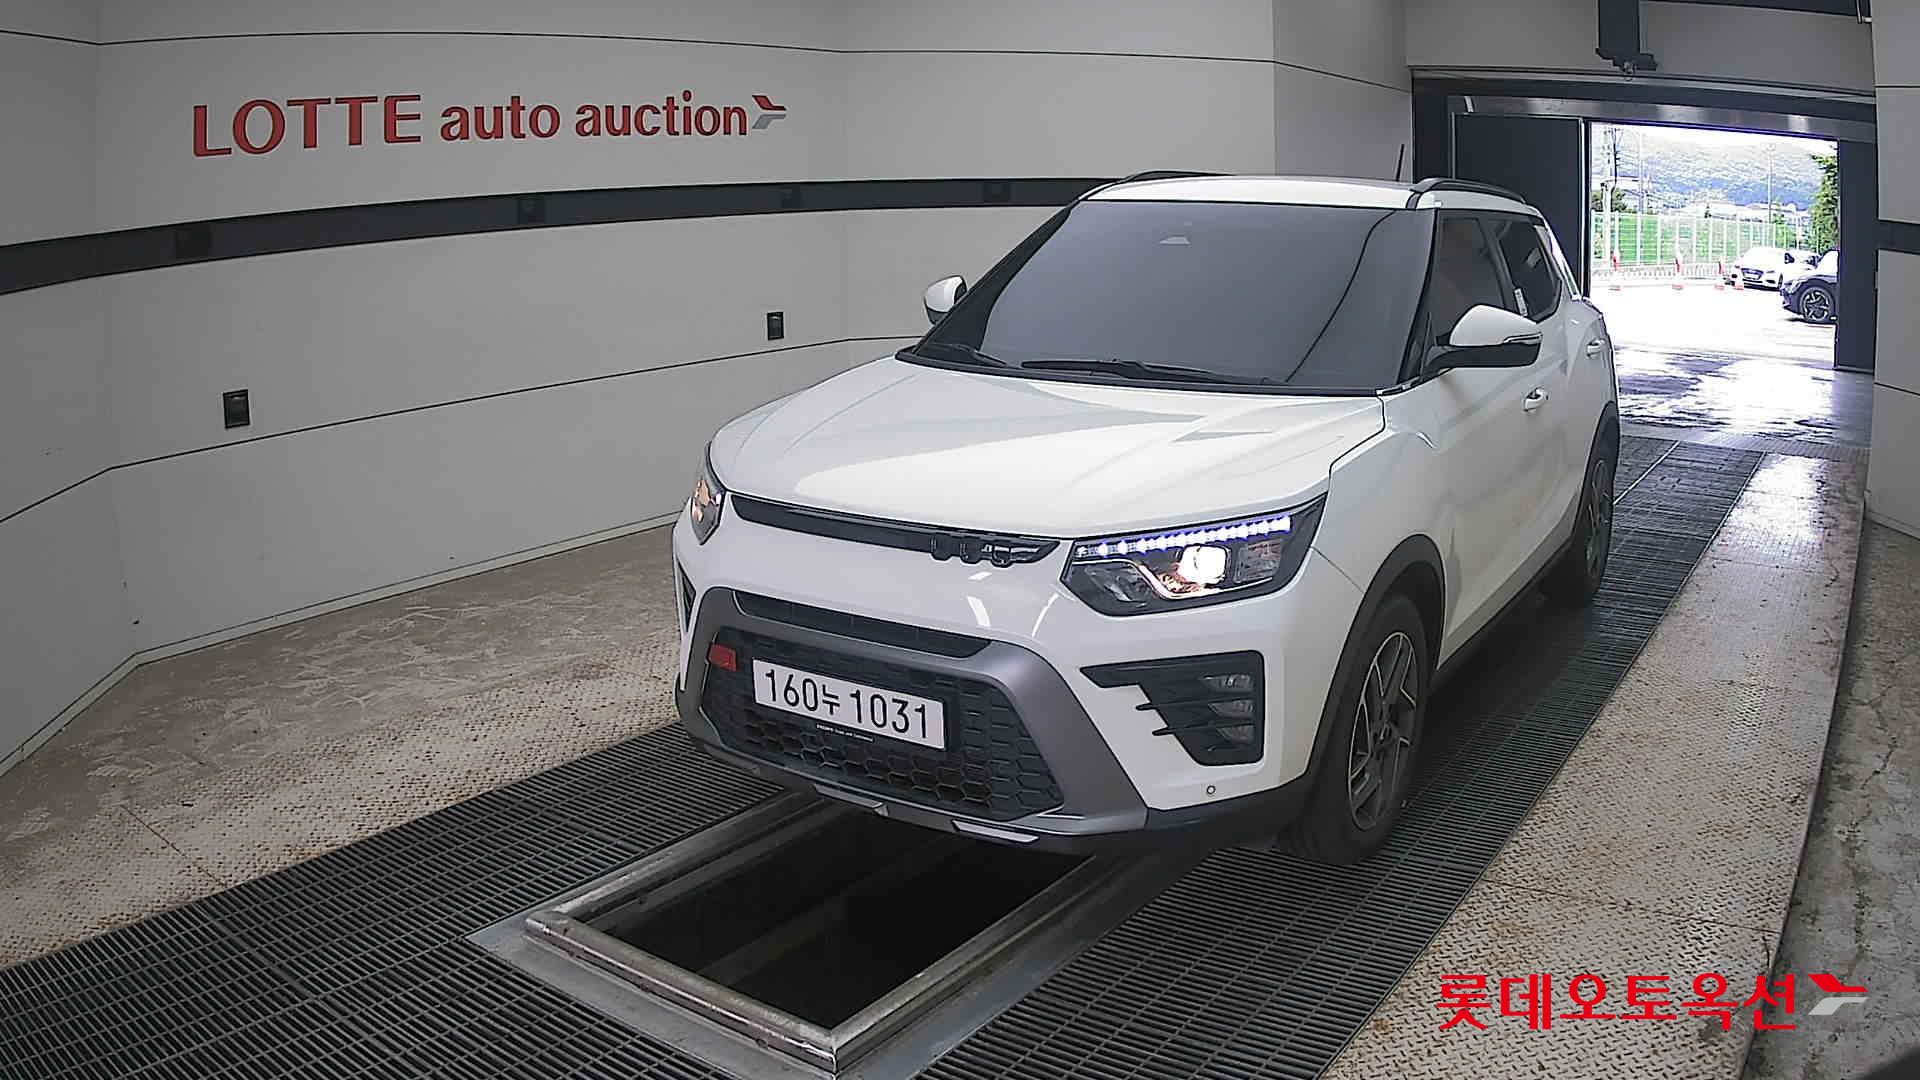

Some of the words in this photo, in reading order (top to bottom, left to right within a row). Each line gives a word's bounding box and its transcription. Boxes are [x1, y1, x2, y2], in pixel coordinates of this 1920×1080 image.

[193, 95, 422, 158] LOTTE
[440, 95, 561, 142] auto
[575, 90, 749, 137] auction
